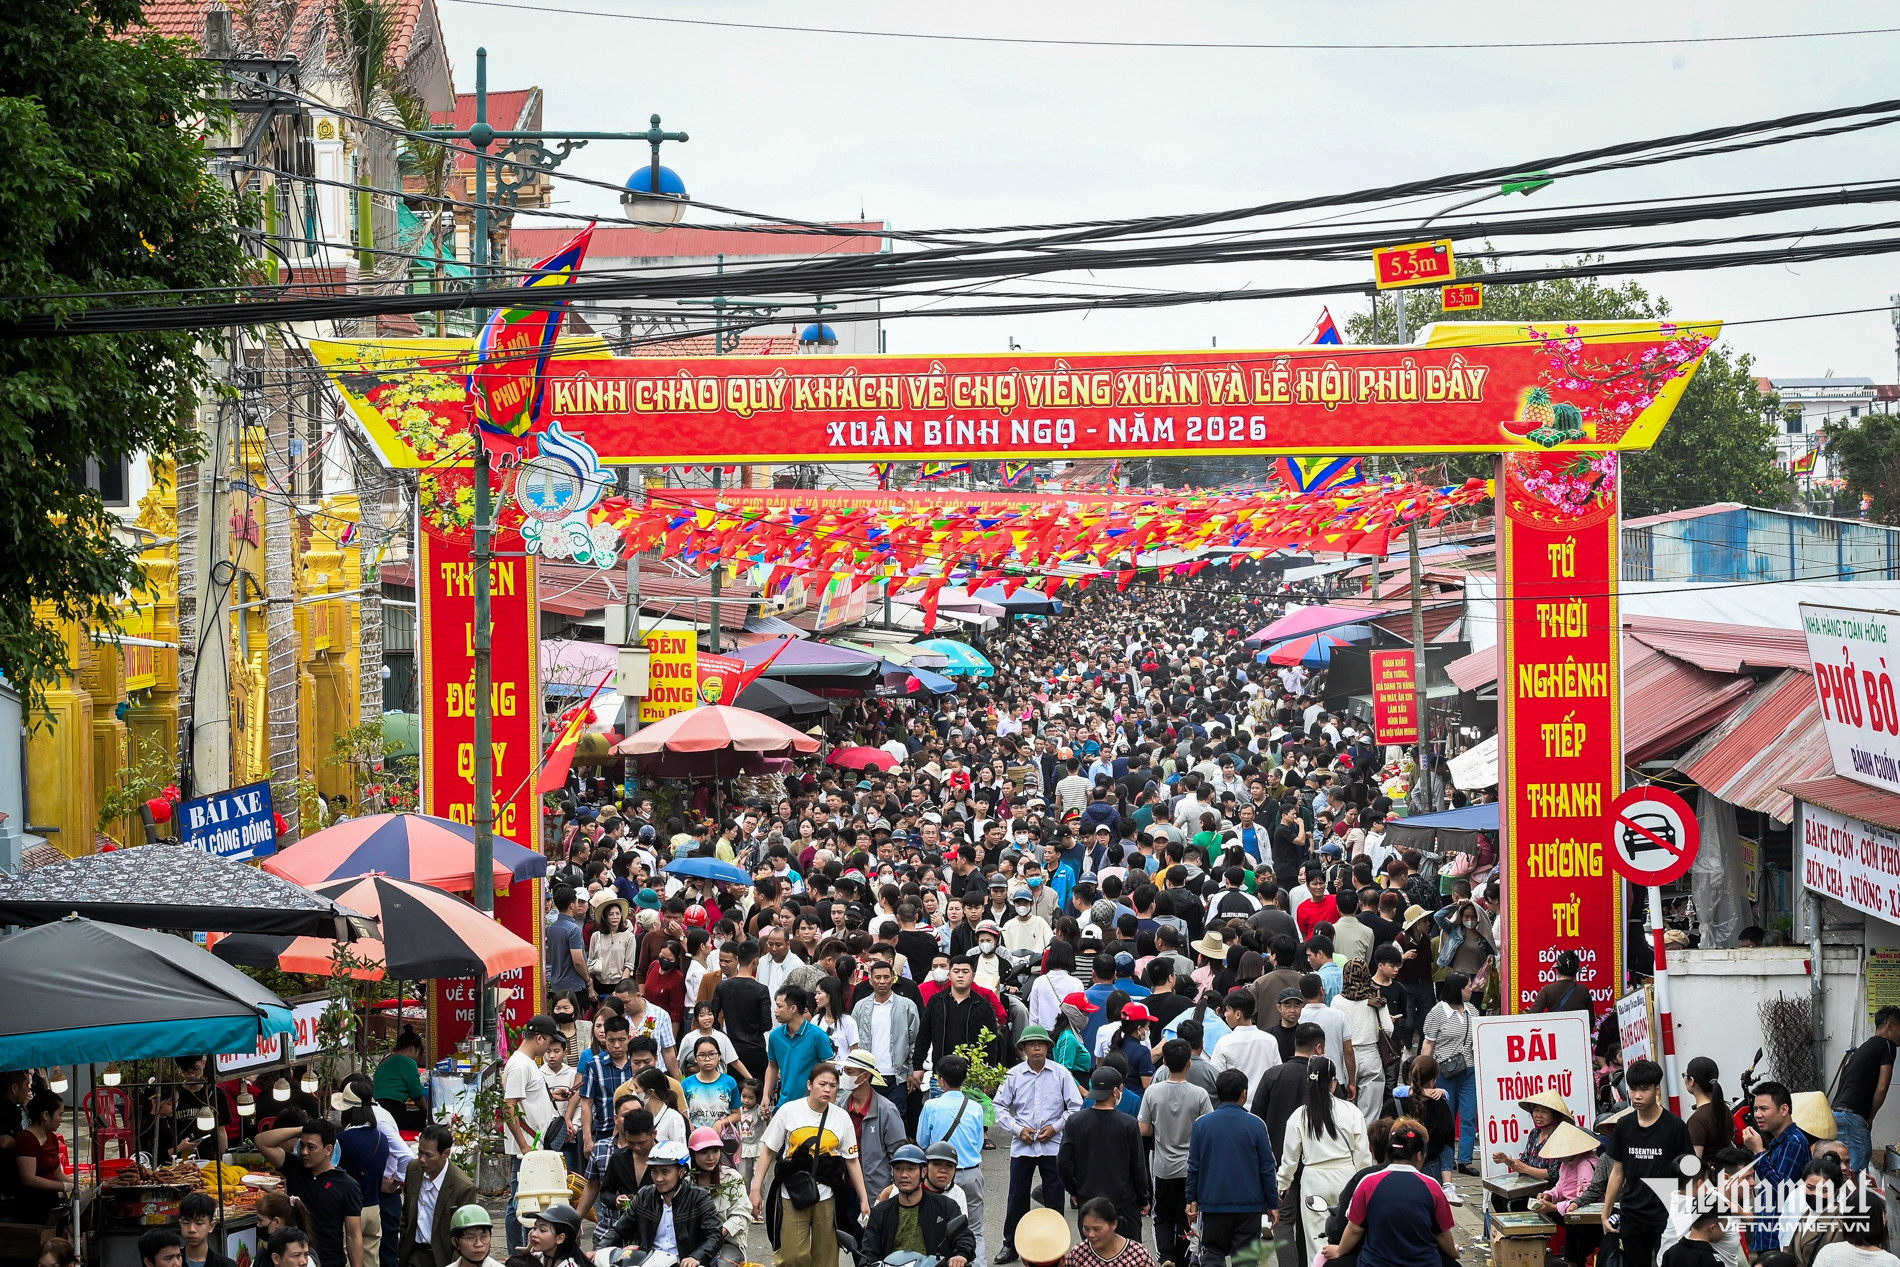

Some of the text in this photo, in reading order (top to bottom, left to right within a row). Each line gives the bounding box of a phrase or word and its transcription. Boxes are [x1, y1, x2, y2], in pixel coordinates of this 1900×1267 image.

[1391, 254, 1437, 276] 5.5m
[1450, 290, 1474, 304] 5.5m
[552, 353, 1490, 419] KÍNH CHÀO QUÝ KHÁCH VỀ CHỢ VIỀNG XUÂN VÀ LỄ HỘI PHỦ DẦY
[826, 415, 912, 447] XUÂN
[923, 415, 1000, 446] BÍNH
[1010, 419, 1076, 450] NGỌ
[1107, 411, 1176, 443] NĂM
[1186, 415, 1268, 441] 2026
[1547, 534, 1577, 578] TỨ
[1536, 598, 1589, 638] THỜI
[1805, 612, 1821, 635] NHÀ
[1821, 613, 1842, 638] HÀNG
[1843, 617, 1864, 641] TOÀN
[649, 660, 692, 679] ÔNG
[1518, 655, 1608, 699] NGHÊNH
[1814, 645, 1899, 737] PHỞ BÒ
[1541, 710, 1587, 758] TIẾP
[457, 742, 507, 784] QY
[1851, 744, 1899, 783] BÁNH CUỐN
[188, 790, 263, 830] BÃI XE
[1527, 783, 1602, 818] THANH
[209, 828, 241, 855] CÔNG
[242, 817, 273, 845] ĐỒNG
[1805, 813, 1829, 852] BÁNH
[1830, 821, 1854, 860] CUỐN
[1527, 838, 1603, 878] HƯƠNG
[1806, 854, 1824, 890] BÚN
[1826, 859, 1844, 898] CHẢ
[1850, 872, 1882, 912] NƯỚNG
[1552, 892, 1580, 938] TỬ
[1538, 963, 1597, 983] ĐÓ IẾP
[1577, 948, 1596, 963] ÙA
[445, 983, 465, 1002] VỀ
[1506, 1028, 1557, 1063] BÃI
[1548, 1069, 1572, 1098] GIỮ
[1488, 1115, 1498, 1144] Ô
[1501, 1114, 1519, 1143] TÔ
[1628, 1147, 1663, 1156] ESSENTIALS
